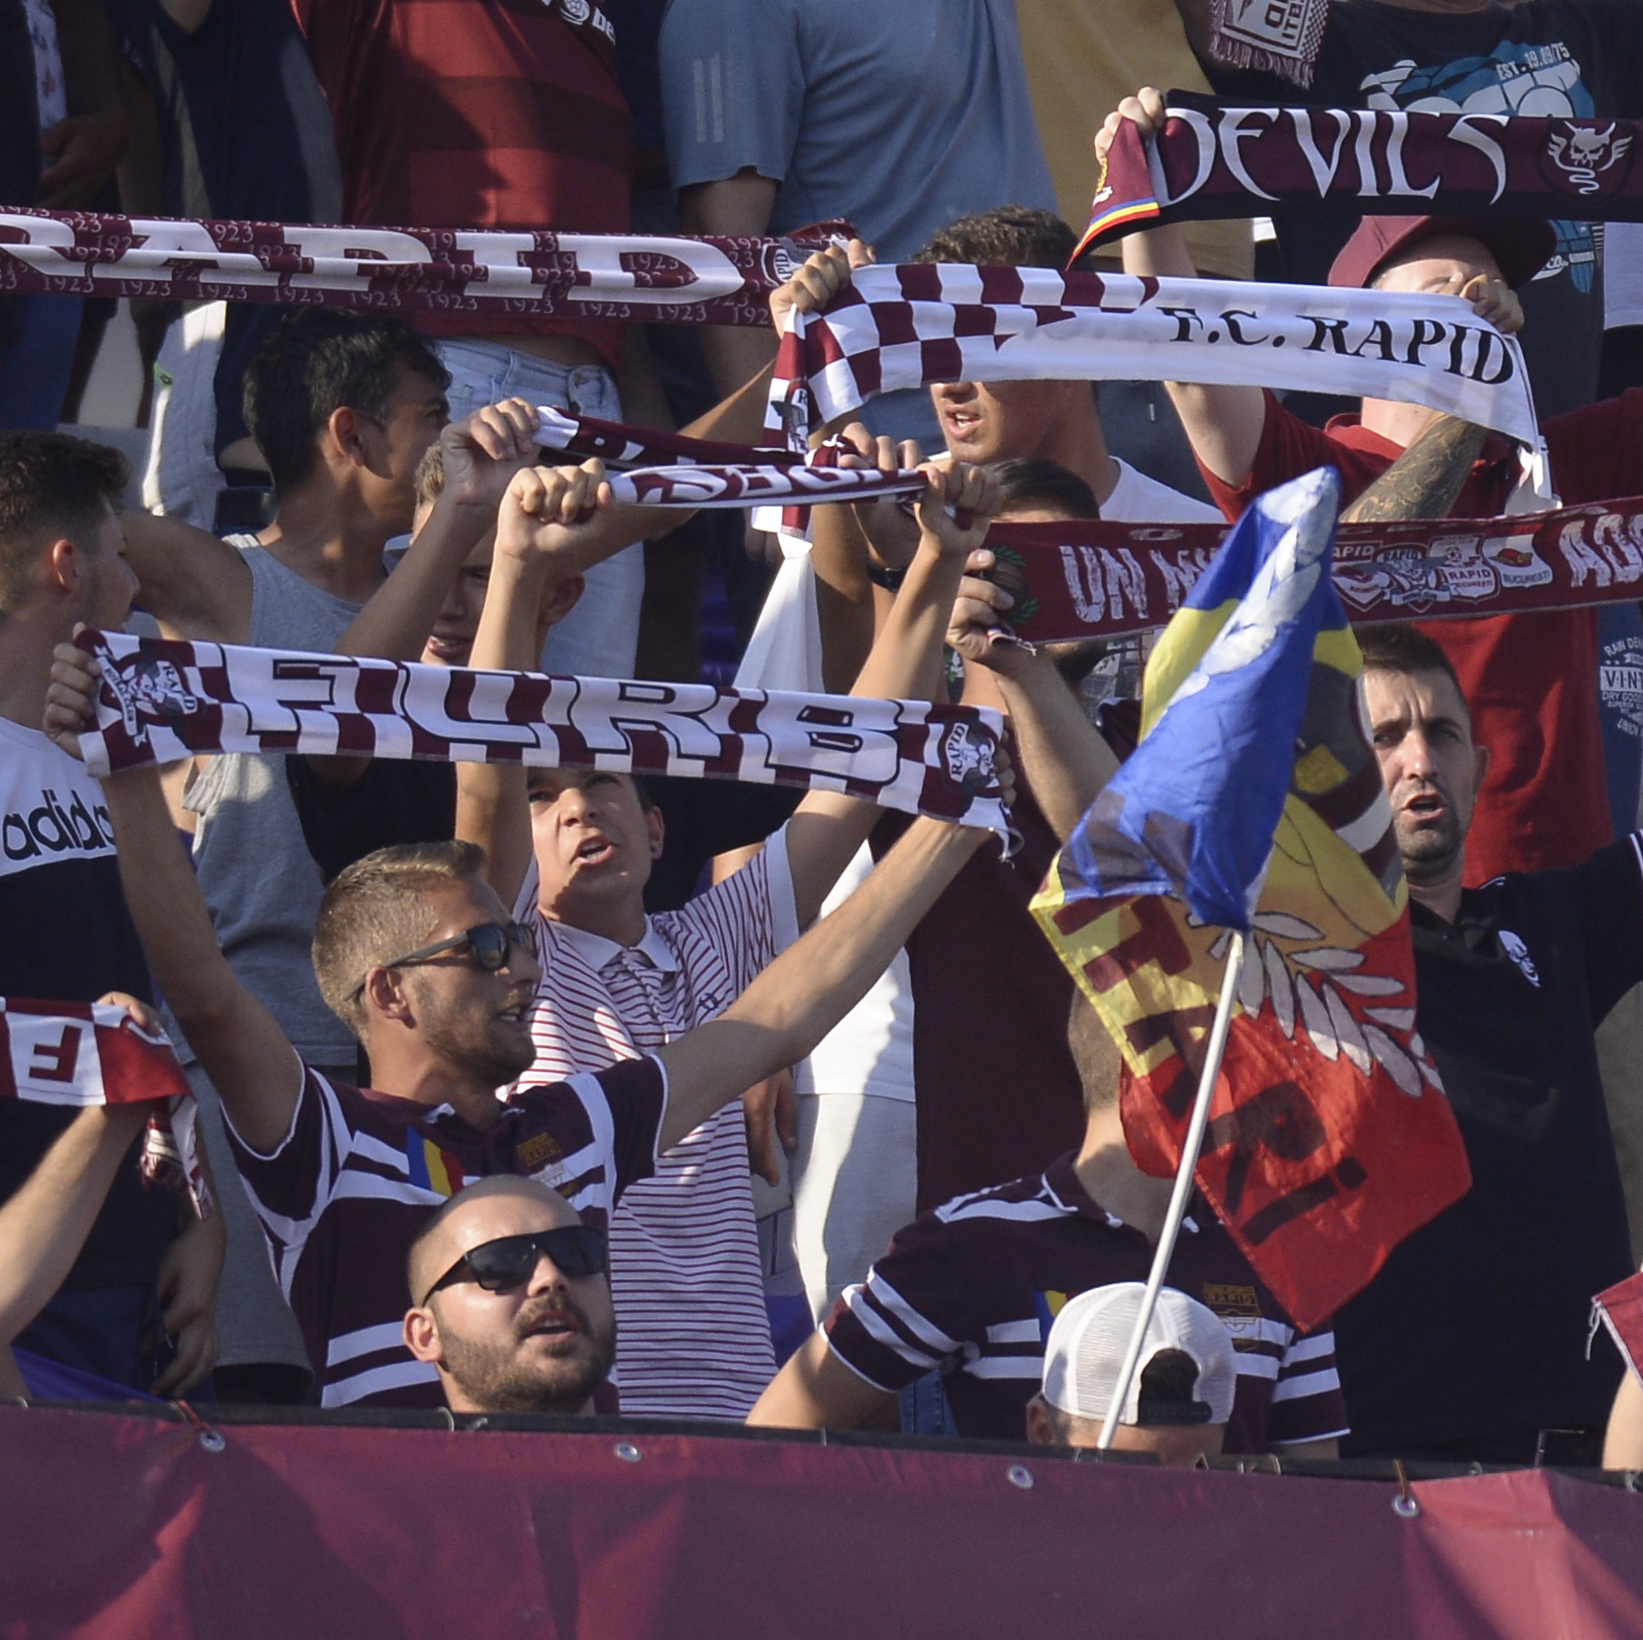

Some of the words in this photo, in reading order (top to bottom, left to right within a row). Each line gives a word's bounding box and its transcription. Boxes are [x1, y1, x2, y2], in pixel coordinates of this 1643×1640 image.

[1302, 315, 1519, 387] RAPID
[1332, 547, 1375, 560] APID
[1448, 568, 1492, 582] RAPID
[951, 723, 967, 778] RAPID
[3, 789, 116, 863] adid
